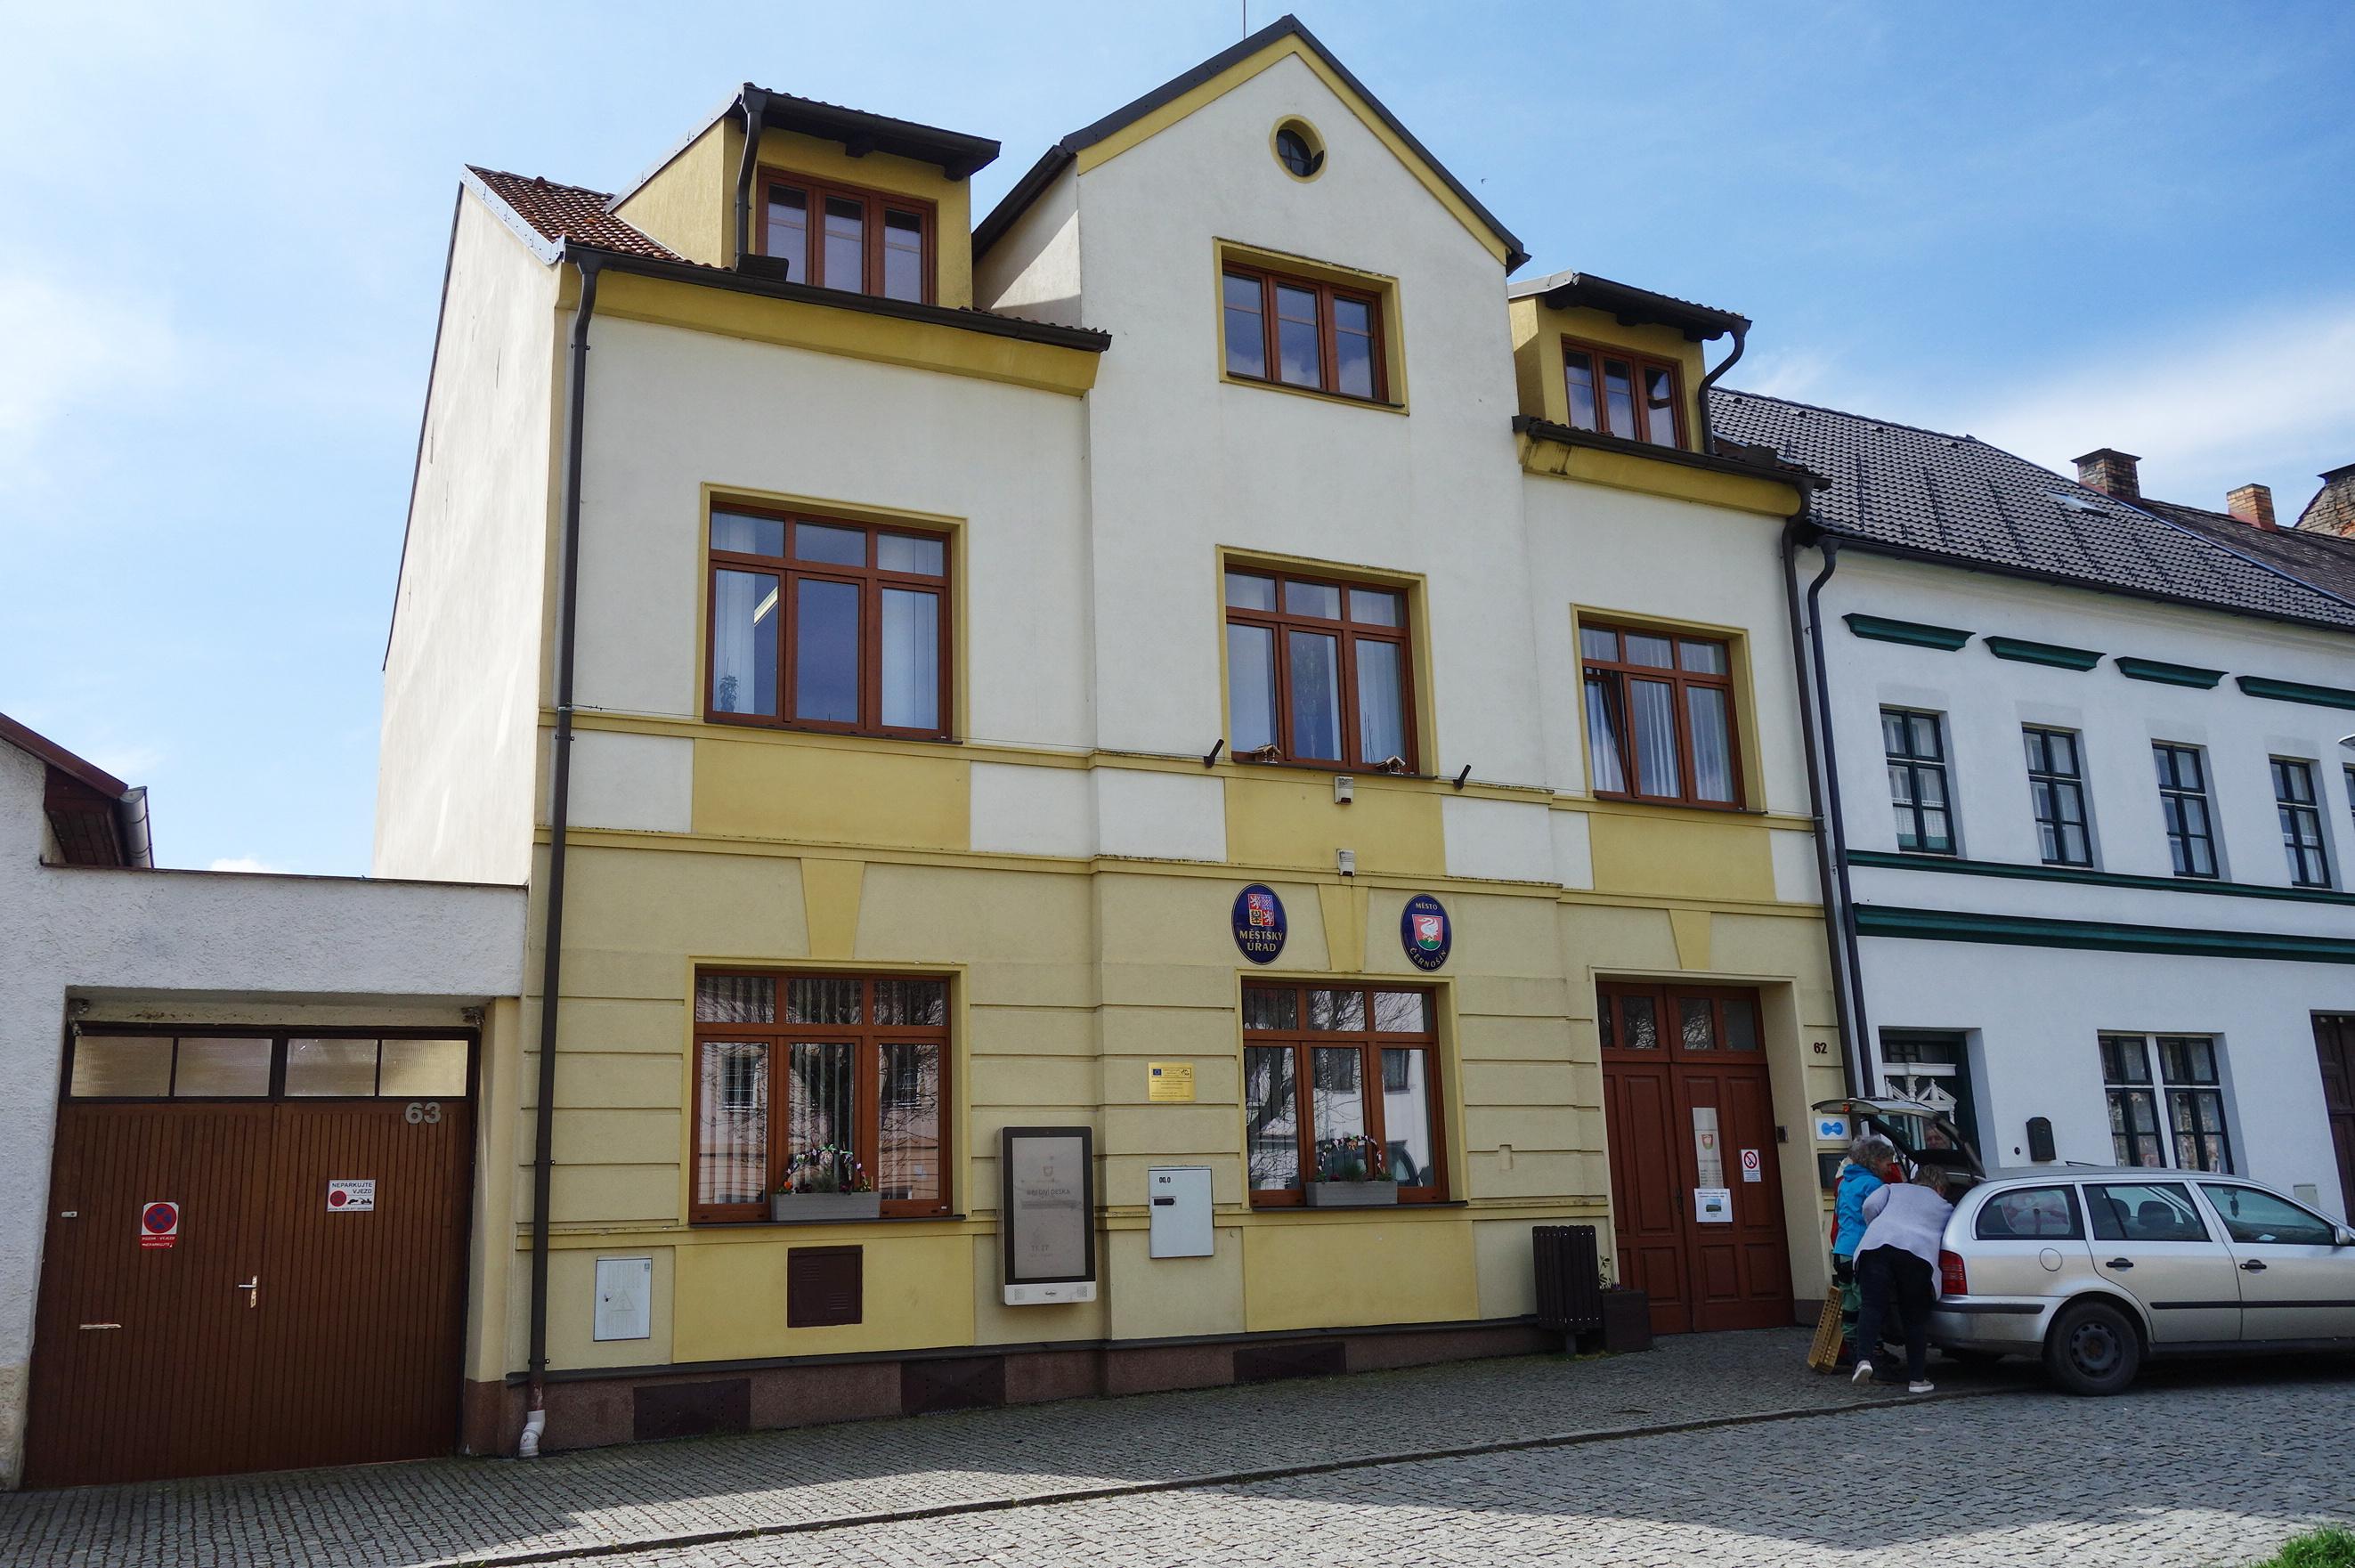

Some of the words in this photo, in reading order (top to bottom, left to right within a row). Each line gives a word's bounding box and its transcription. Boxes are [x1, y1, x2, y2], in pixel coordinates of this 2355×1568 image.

[1415, 902, 1438, 911] MĚSTO
[1239, 929, 1283, 941] MĚSTSKÝ
[1247, 940, 1277, 952] ÚŘAD
[1409, 947, 1447, 968] ČERNOŠÍN
[1814, 1042, 1828, 1054] 62
[405, 1101, 442, 1125] 63
